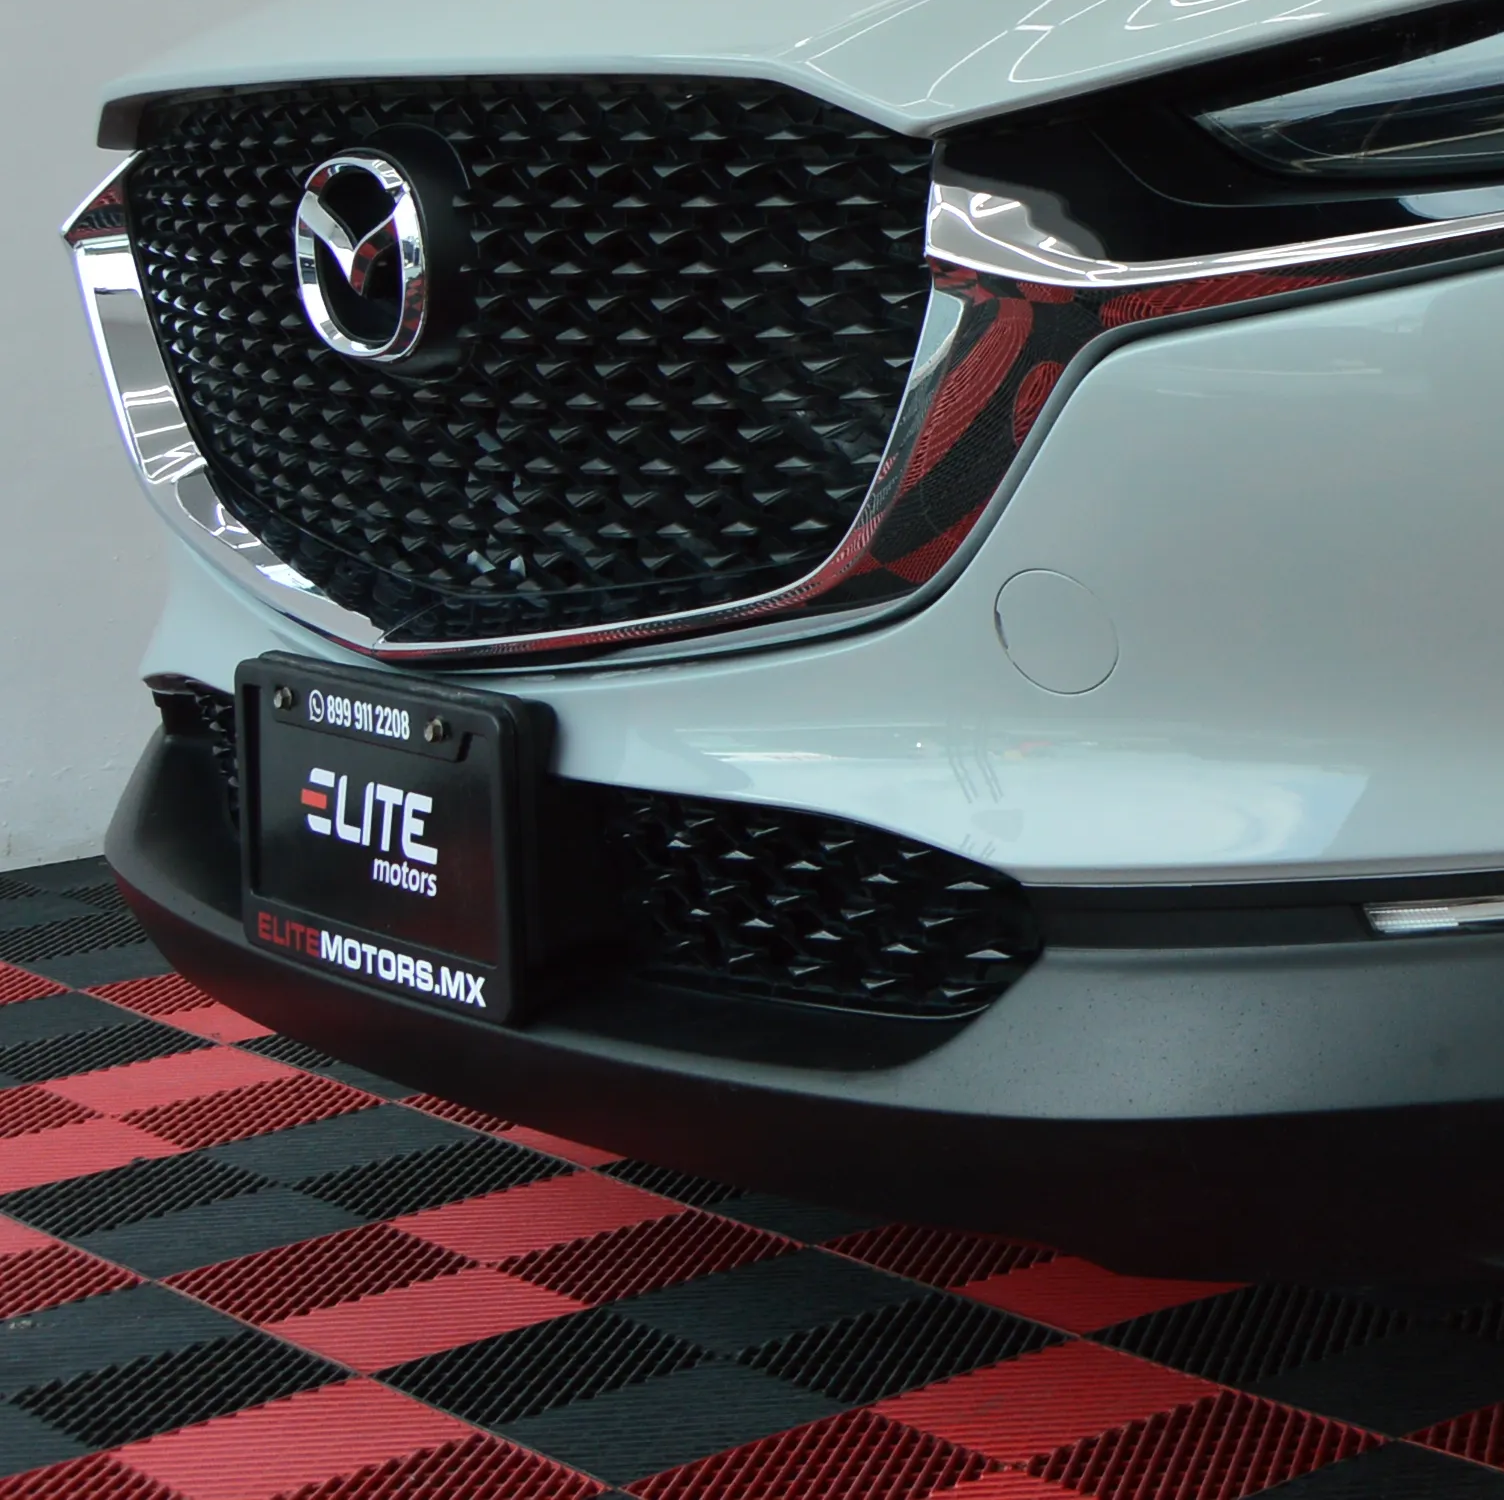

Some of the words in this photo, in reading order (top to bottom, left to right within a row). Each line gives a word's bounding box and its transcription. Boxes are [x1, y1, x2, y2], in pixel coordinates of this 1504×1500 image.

[327, 694, 352, 727] 899
[354, 700, 373, 732] 911
[375, 705, 410, 740] 2208
[301, 767, 438, 865] ELITE
[372, 857, 438, 897] motors
[257, 911, 487, 1008] ELITEMOTORS.MX
